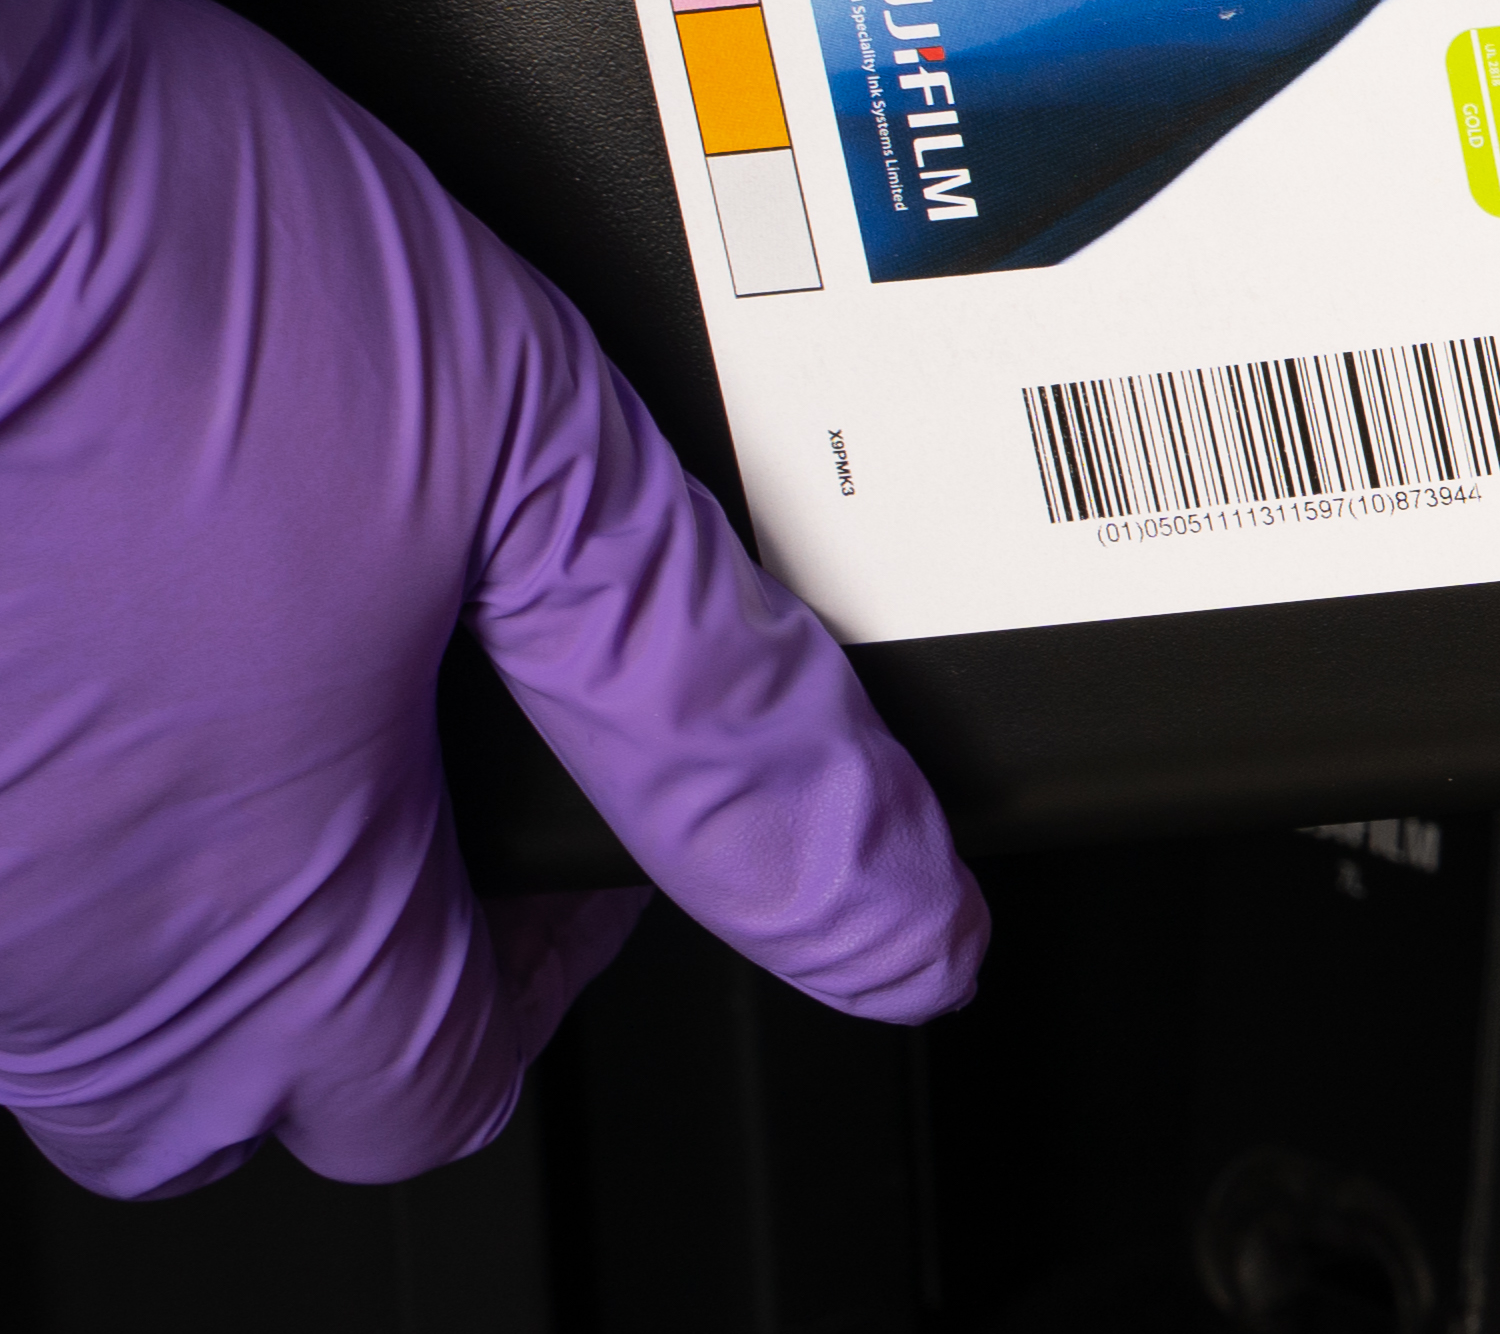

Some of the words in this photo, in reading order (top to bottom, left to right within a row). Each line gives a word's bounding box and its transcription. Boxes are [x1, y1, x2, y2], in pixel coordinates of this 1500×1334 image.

[850, 5, 877, 72] Speciality
[1485, 43, 1497, 59] UL
[867, 74, 885, 98] Ink
[870, 100, 894, 157] Systems
[1462, 102, 1484, 149] GOLD
[885, 159, 909, 212] Limited
[827, 429, 856, 497] X9PMK3
[1096, 482, 1483, 548] (01)05051111311597(10)873944
